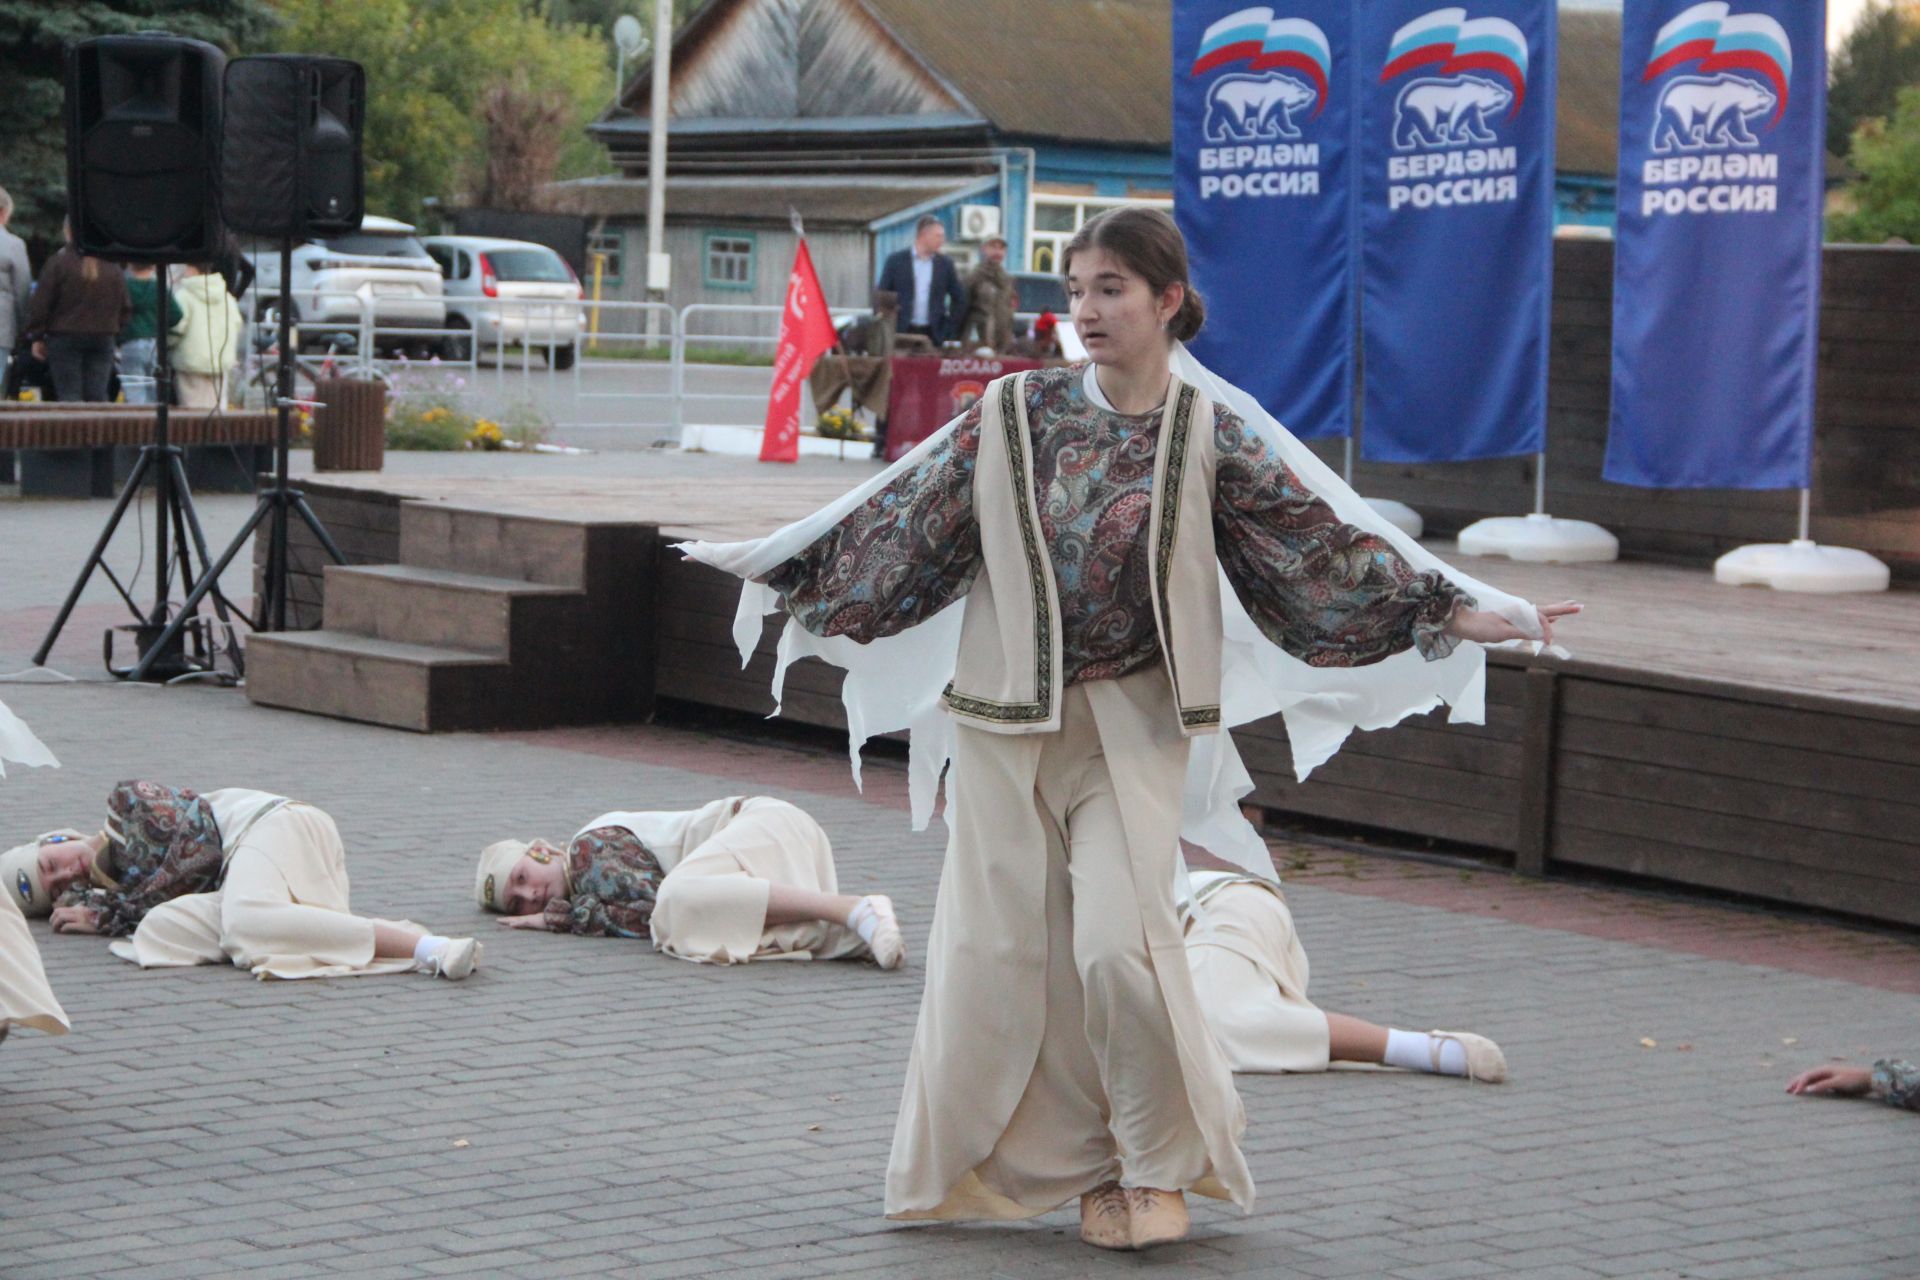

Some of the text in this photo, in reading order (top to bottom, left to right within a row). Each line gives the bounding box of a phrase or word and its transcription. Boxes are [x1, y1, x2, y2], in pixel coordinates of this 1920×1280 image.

[1199, 143, 1320, 170] БЕРДӘМ
[1388, 146, 1517, 179] БЕРДӘМ
[1643, 153, 1778, 183] БЕРДӘМ
[1200, 171, 1320, 199] РОССИЯ
[1389, 175, 1518, 210] РОССИЯ
[1643, 184, 1778, 216] РОССИЯ
